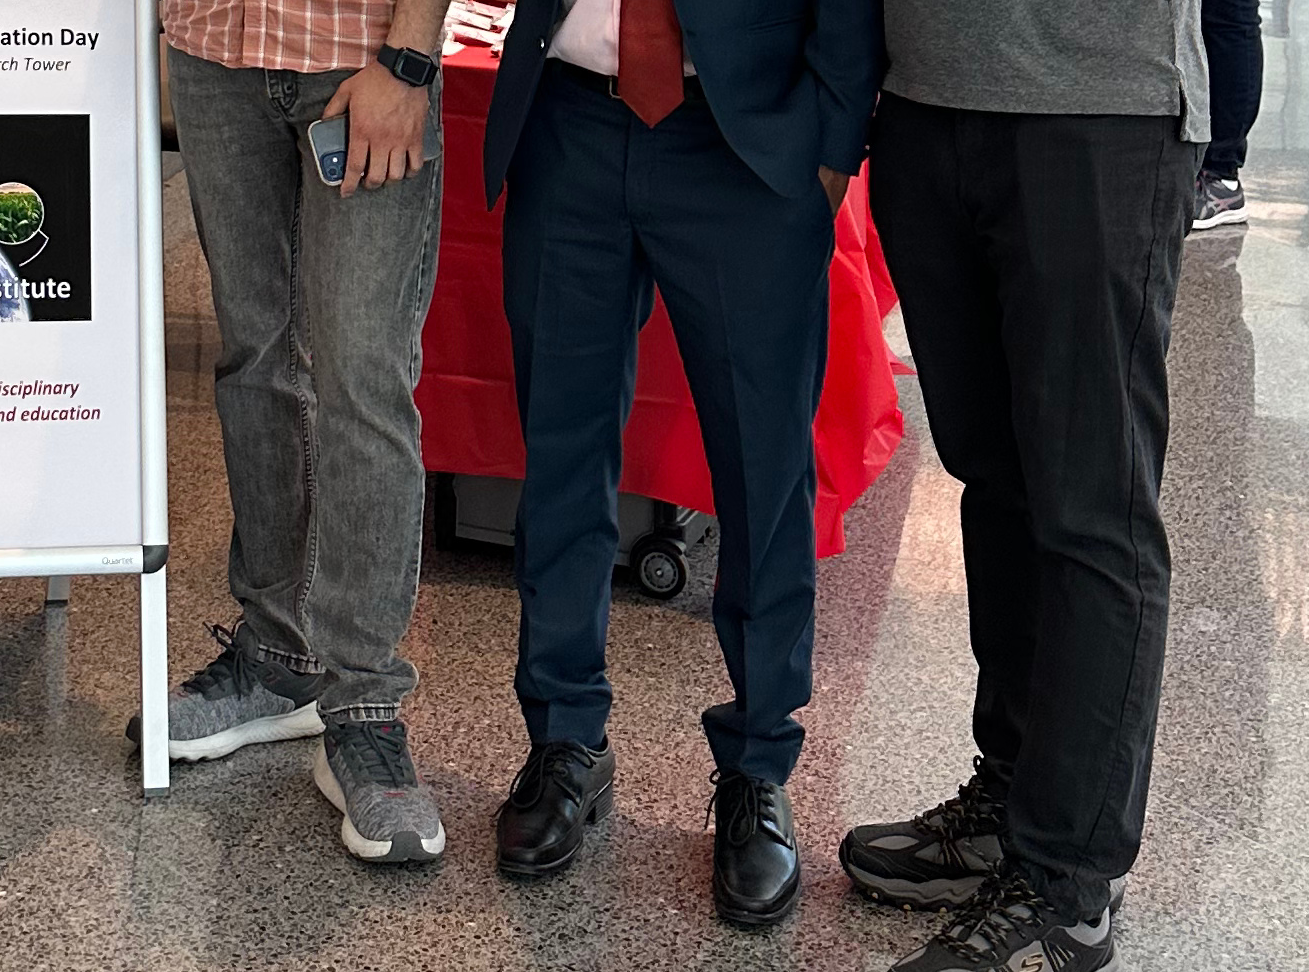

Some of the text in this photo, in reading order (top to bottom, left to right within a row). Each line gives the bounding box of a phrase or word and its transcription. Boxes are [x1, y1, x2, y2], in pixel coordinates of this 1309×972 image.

[61, 28, 100, 50] Day
[24, 58, 71, 71] Tower
[20, 405, 101, 422] education
